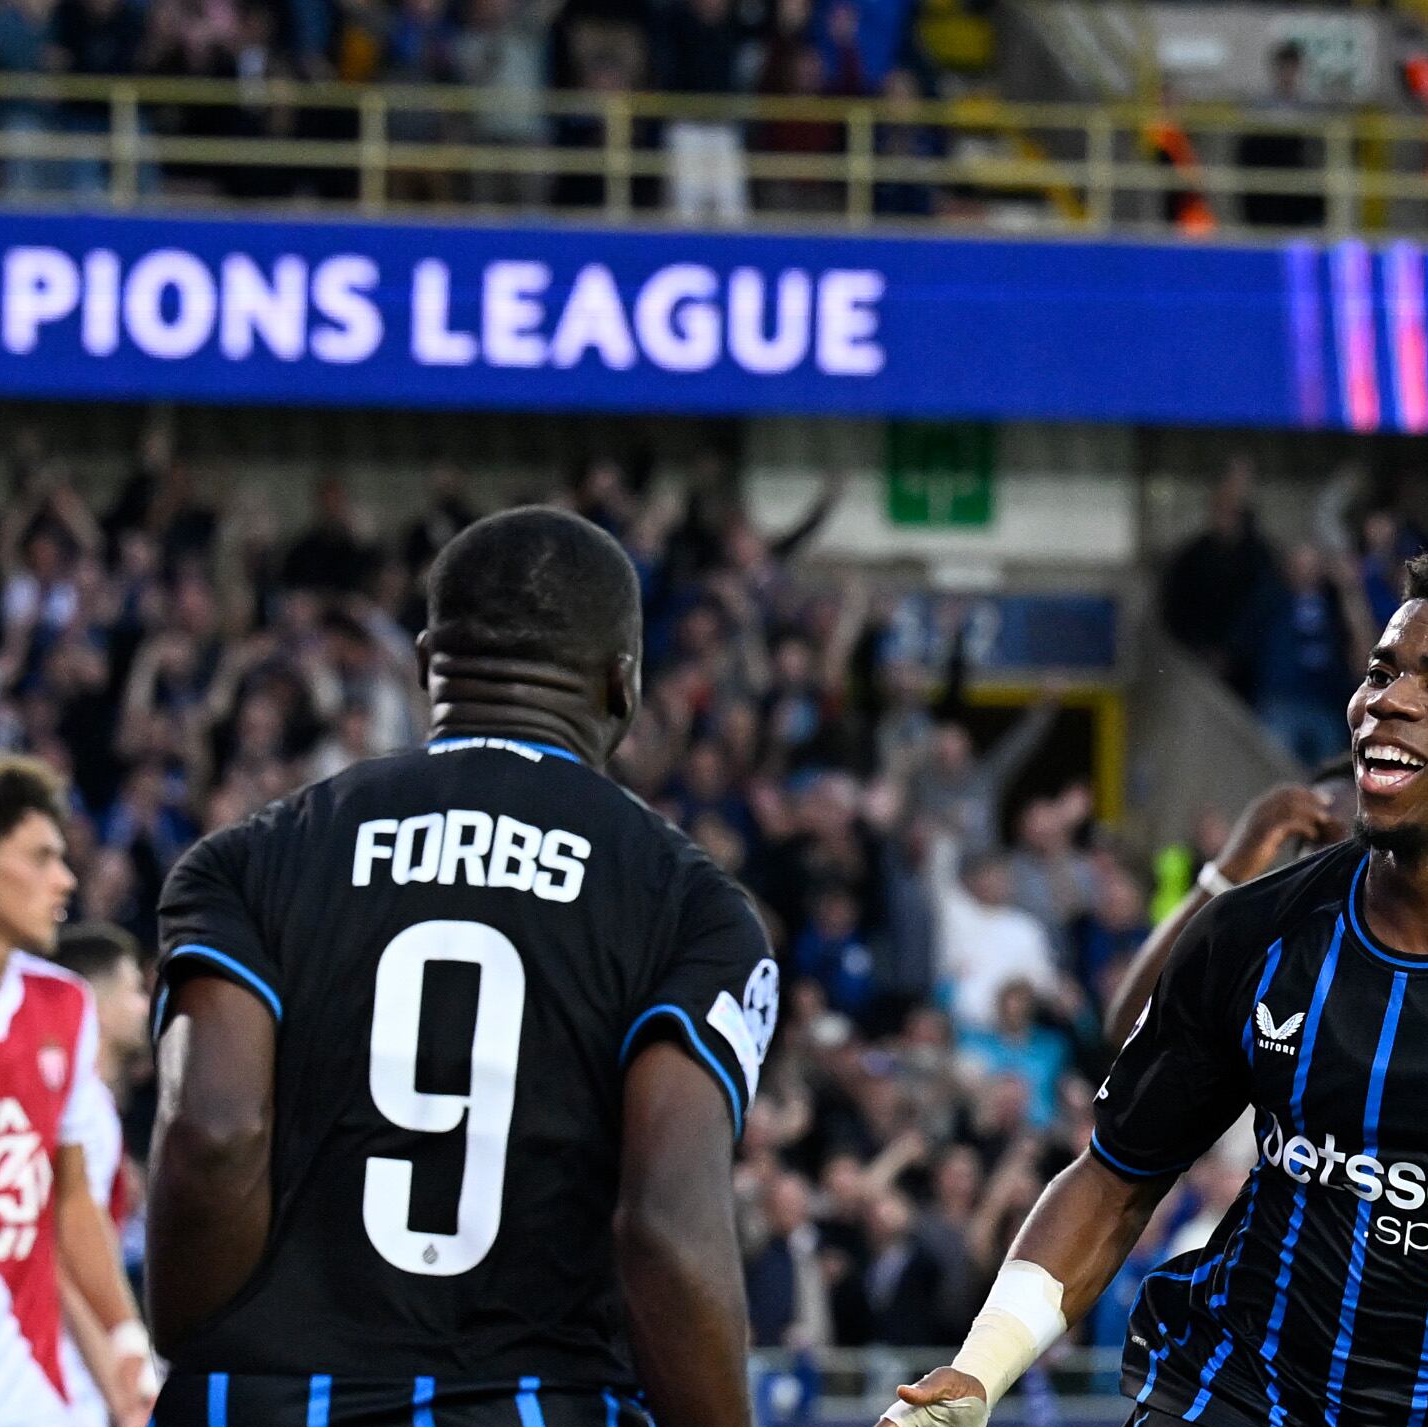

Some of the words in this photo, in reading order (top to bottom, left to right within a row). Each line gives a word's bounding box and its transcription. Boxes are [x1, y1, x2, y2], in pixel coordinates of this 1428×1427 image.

[410, 256, 886, 377] LEAGUE
[351, 808, 592, 903] FORBS
[362, 919, 526, 1277] 9
[1257, 1038, 1296, 1056] ASTORE
